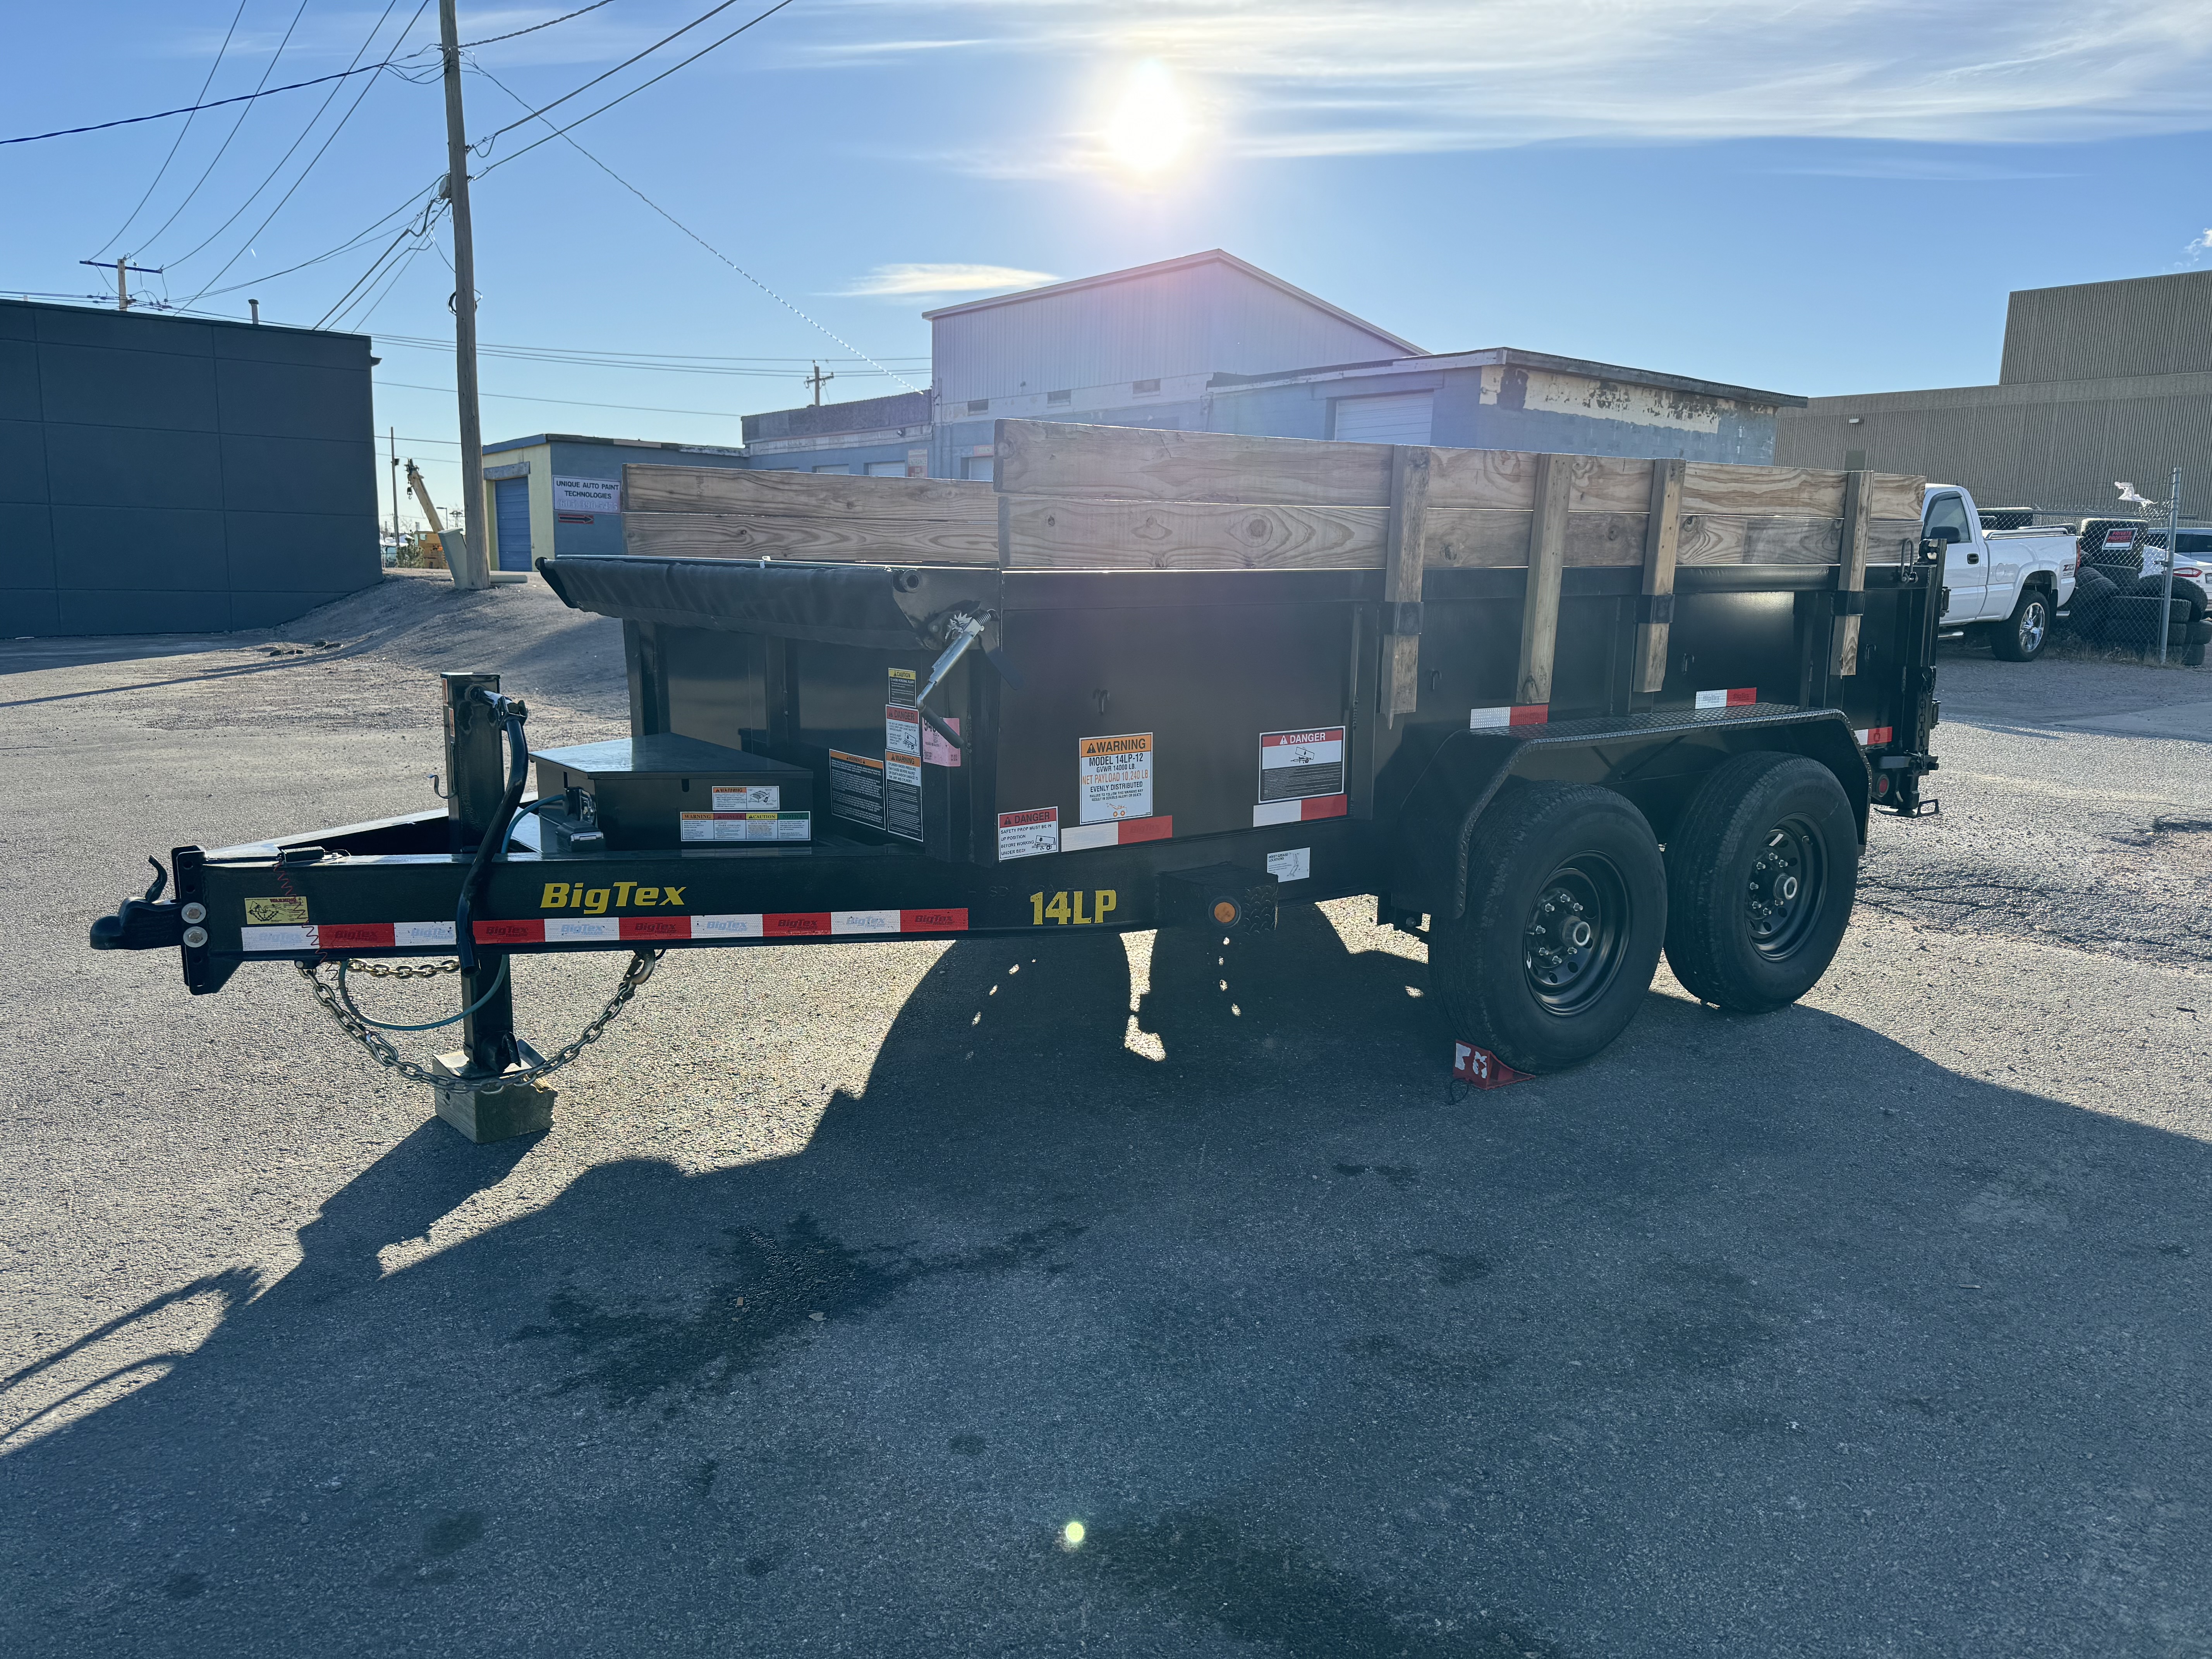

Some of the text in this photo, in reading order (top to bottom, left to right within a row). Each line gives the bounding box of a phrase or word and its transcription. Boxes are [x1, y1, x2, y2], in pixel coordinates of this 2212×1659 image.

[564, 490, 612, 499] TECHNOLOGIES
[894, 710, 914, 721] DANGER
[1290, 732, 1326, 744] DANGER
[1097, 738, 1146, 753] WARNING
[895, 754, 914, 764] WARNING
[1089, 753, 1143, 766] MODEL 14LP-12
[1082, 769, 1150, 785] NET PAYLOAD 10,240 LB.
[1091, 781, 1143, 792] EVENLY DISTRIBUTED
[1015, 812, 1049, 824] DANGER
[539, 881, 687, 914] BigTex
[1030, 889, 1117, 925] 14LP
[778, 919, 819, 928] BigTex
[846, 916, 885, 926] BigTex
[915, 915, 953, 924] BigTex
[486, 926, 529, 936] BigTex
[561, 924, 603, 934] BigTex
[635, 922, 676, 932] BigTex
[706, 921, 747, 931] BigTex
[334, 930, 378, 940] BigTex
[411, 928, 453, 938] BigTex
